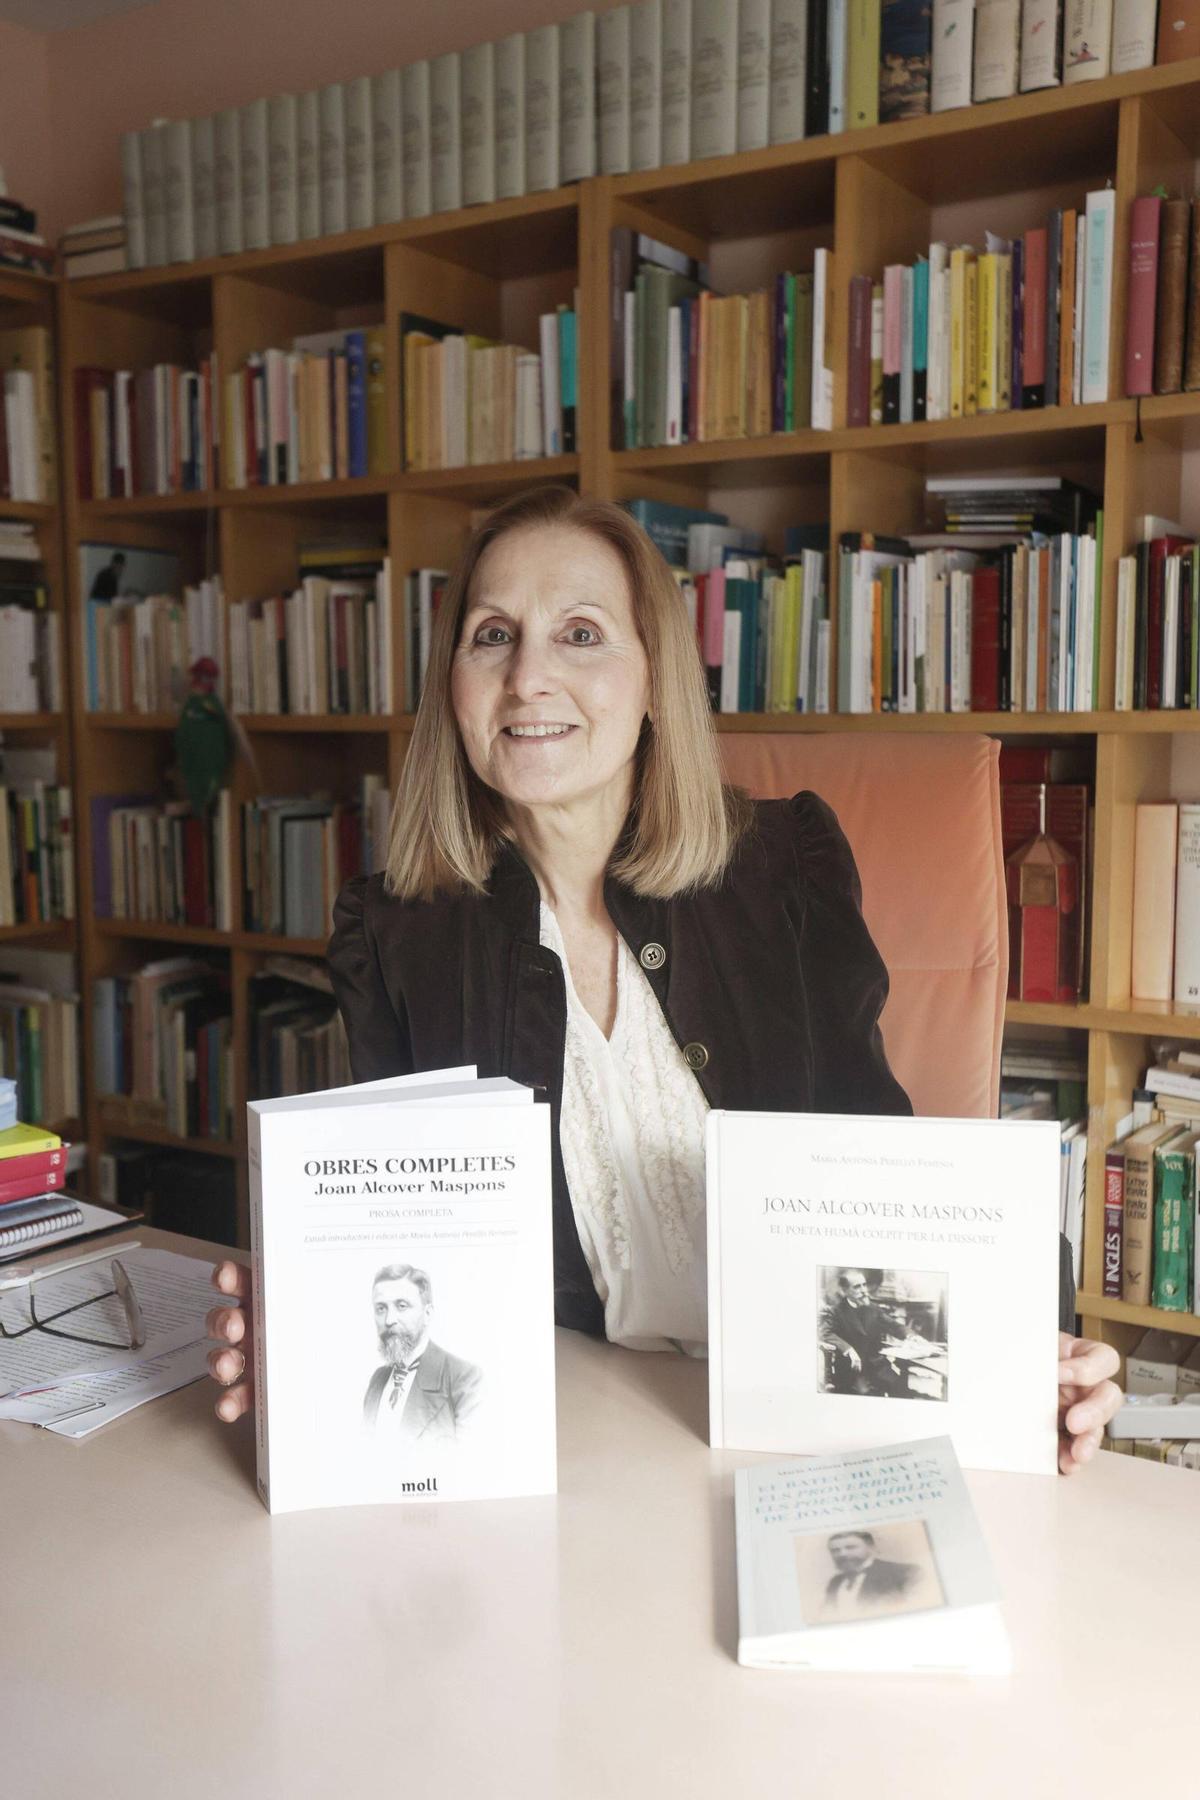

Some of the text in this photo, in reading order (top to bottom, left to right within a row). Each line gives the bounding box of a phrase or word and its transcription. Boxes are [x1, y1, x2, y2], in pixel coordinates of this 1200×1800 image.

[304, 1154, 516, 1176] OBRES COMPLETES
[314, 1179, 506, 1195] Joan Alcover Maspons
[369, 1208, 454, 1219] PROSA COMPLETA
[762, 1197, 1005, 1223] JOAN ALCOVER MASPONS
[769, 1224, 782, 1235] EL
[785, 1225, 822, 1237] POETA
[862, 1229, 905, 1241] COLPIT
[907, 1230, 929, 1242] PER
[931, 1232, 945, 1243] LA
[947, 1233, 997, 1246] DISSORT
[1104, 1231, 1121, 1283] INGLÉS
[401, 1477, 439, 1493] moll
